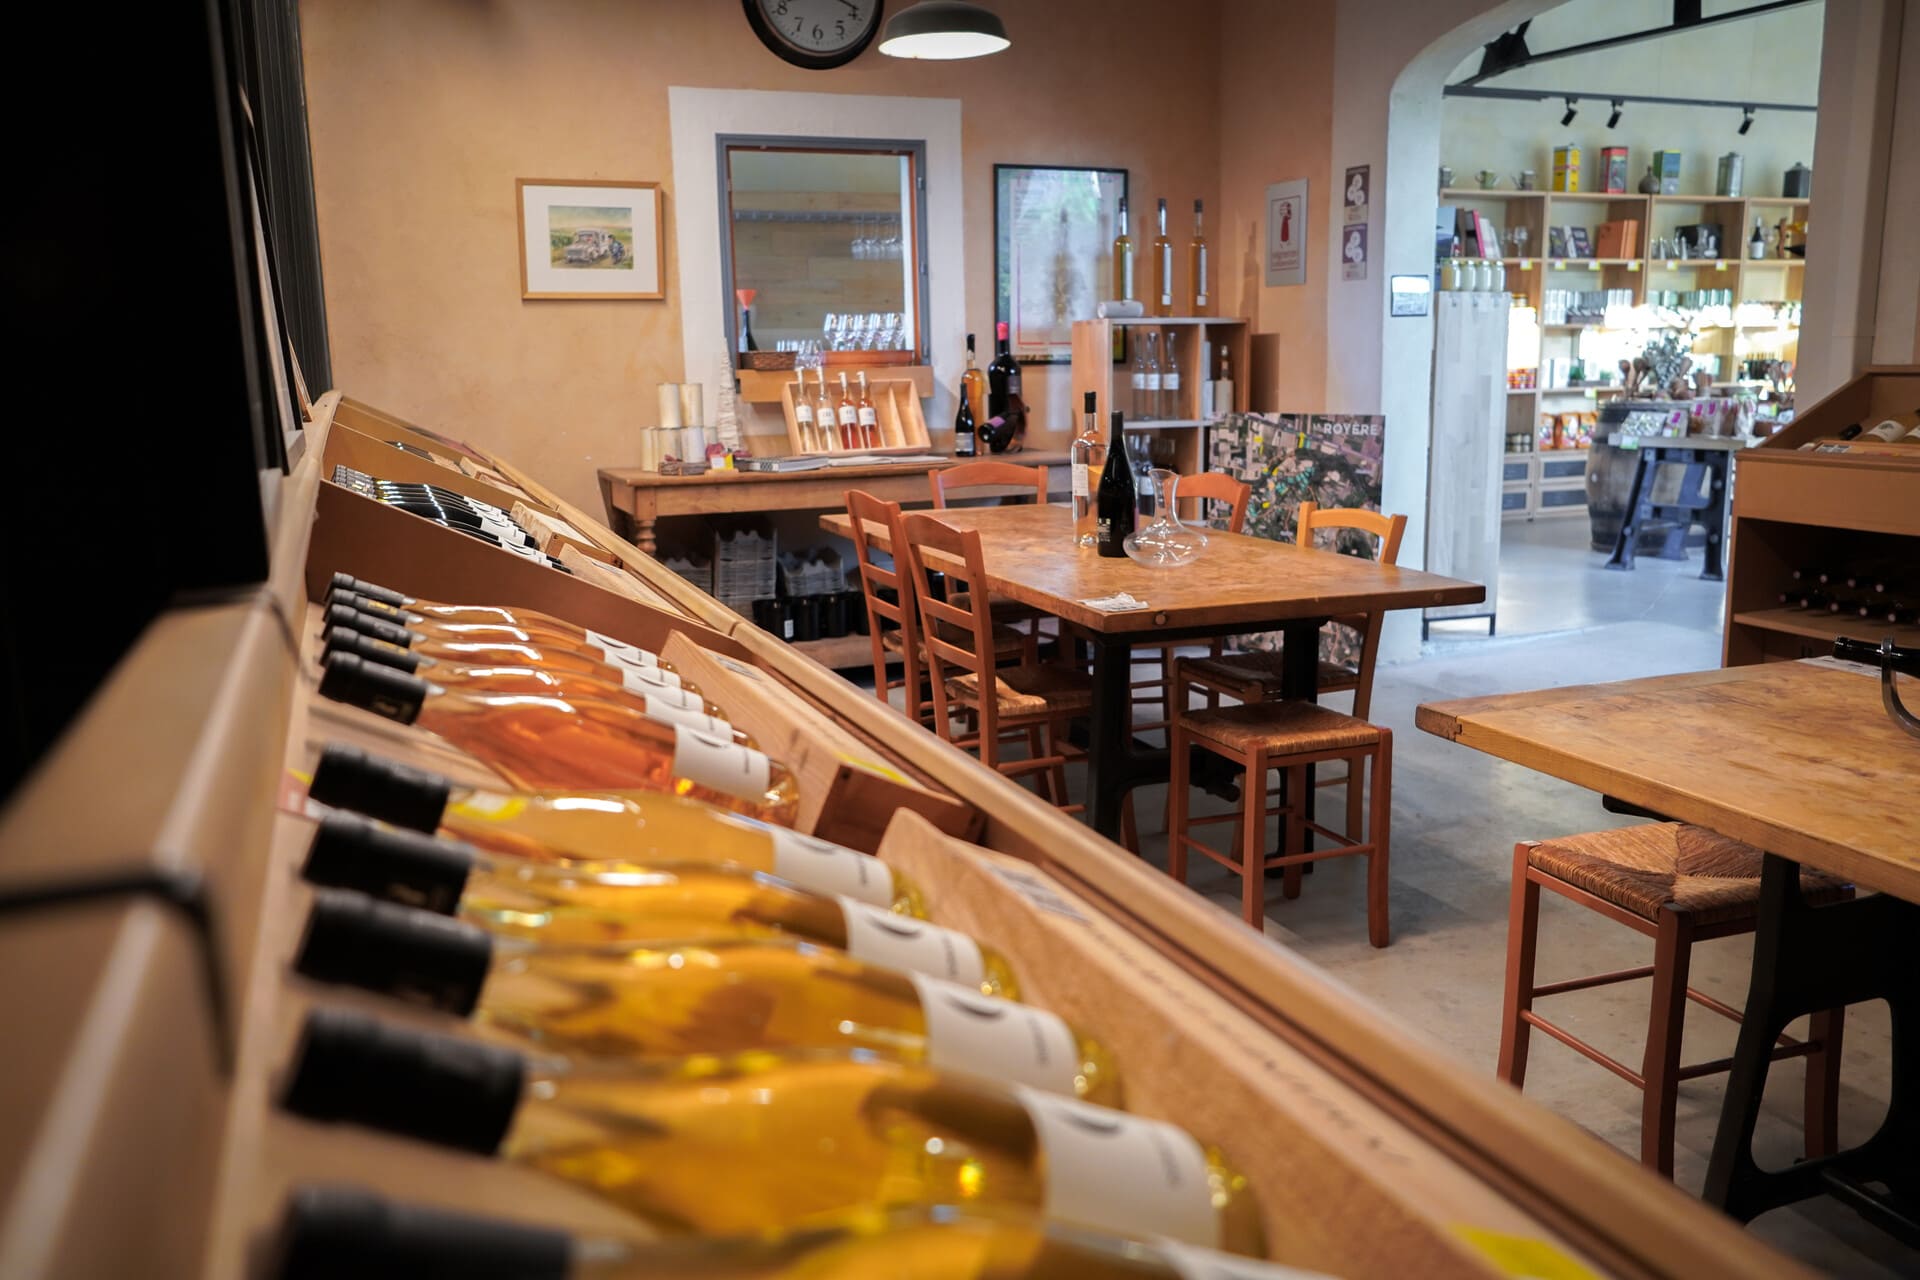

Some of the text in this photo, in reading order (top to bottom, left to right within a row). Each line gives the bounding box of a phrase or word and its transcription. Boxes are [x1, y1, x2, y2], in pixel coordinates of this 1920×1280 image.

[777, 0, 788, 15] 8
[794, 16, 804, 32] 7
[812, 24, 824, 40] 6
[835, 20, 845, 36] 5
